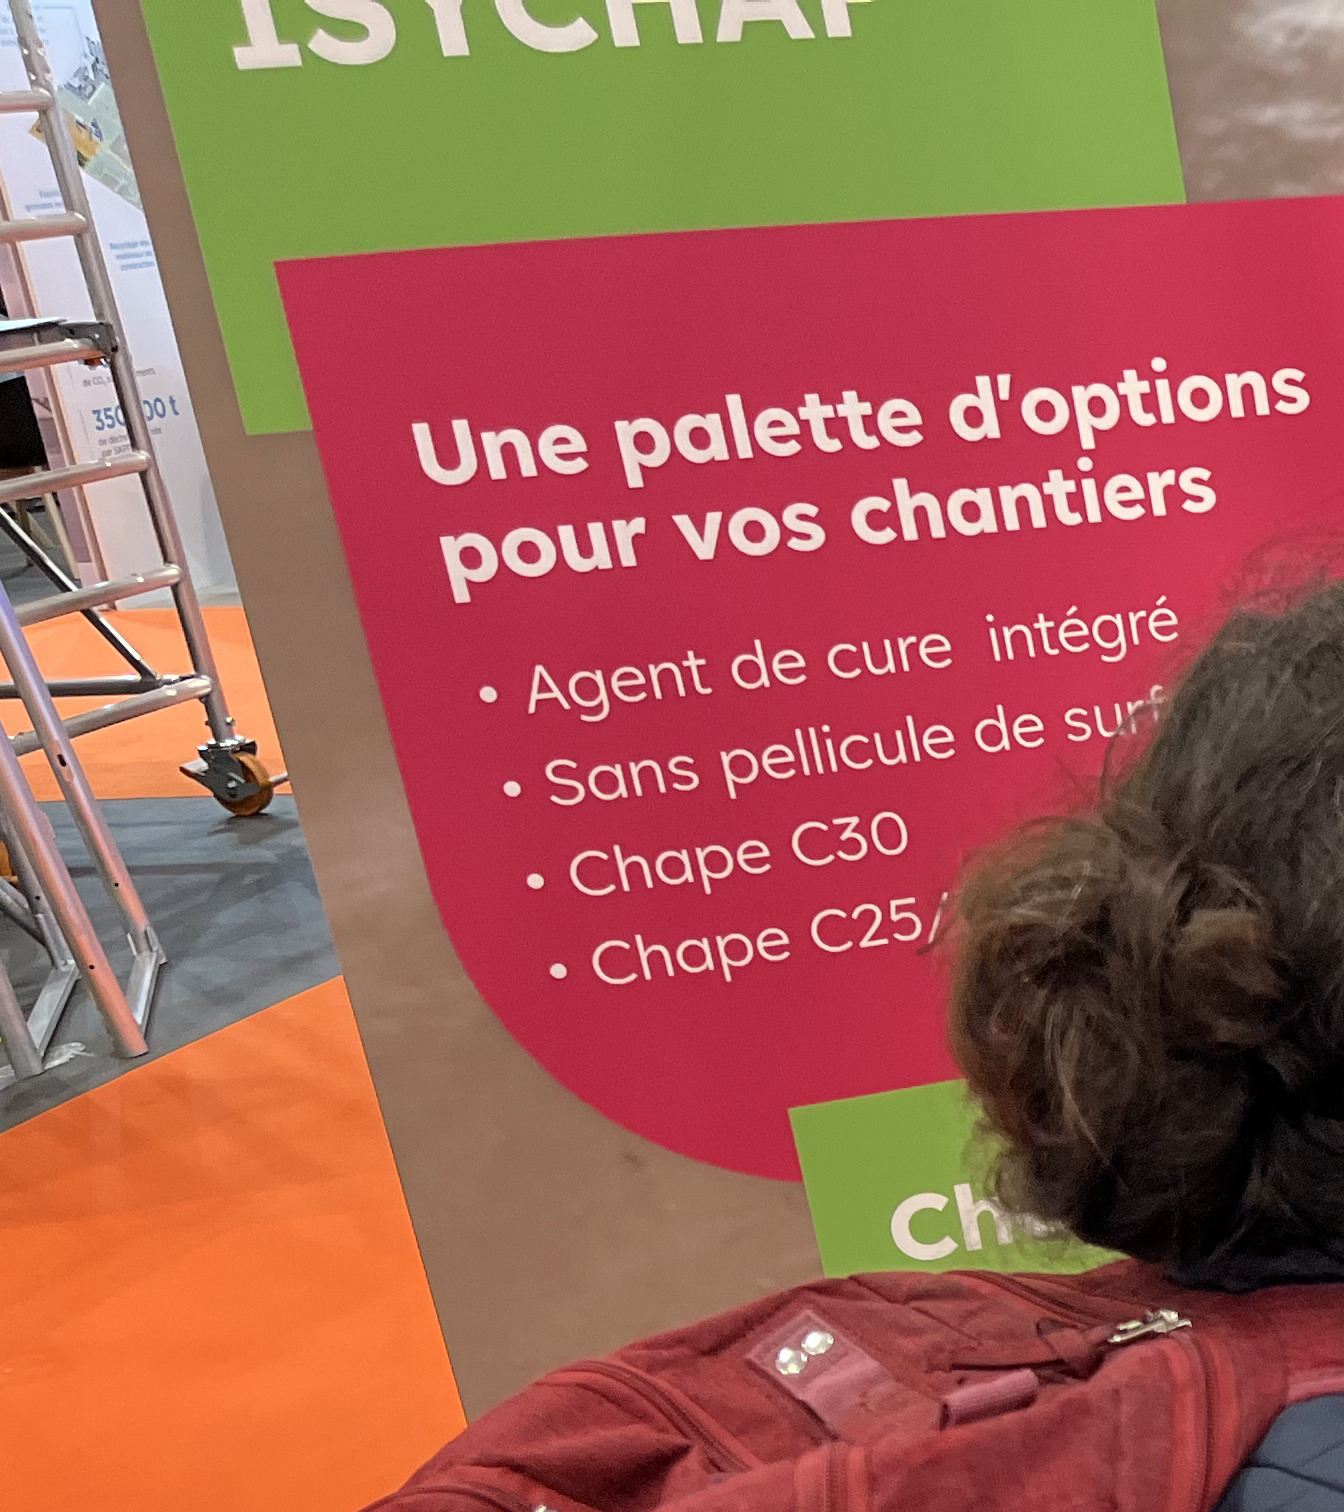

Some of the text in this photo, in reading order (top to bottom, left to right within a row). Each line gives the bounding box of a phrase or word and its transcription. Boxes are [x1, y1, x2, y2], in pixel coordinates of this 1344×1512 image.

[411, 356, 1310, 489] Une palette d'options
[439, 454, 1217, 604] pour vos chantiers
[527, 595, 1181, 723] Agent de cure intégré
[545, 752, 701, 807] Sans
[720, 715, 956, 800] pellicule
[974, 704, 1045, 754] de
[568, 811, 908, 897] Chape C30
[592, 893, 955, 986] Chape C25/
